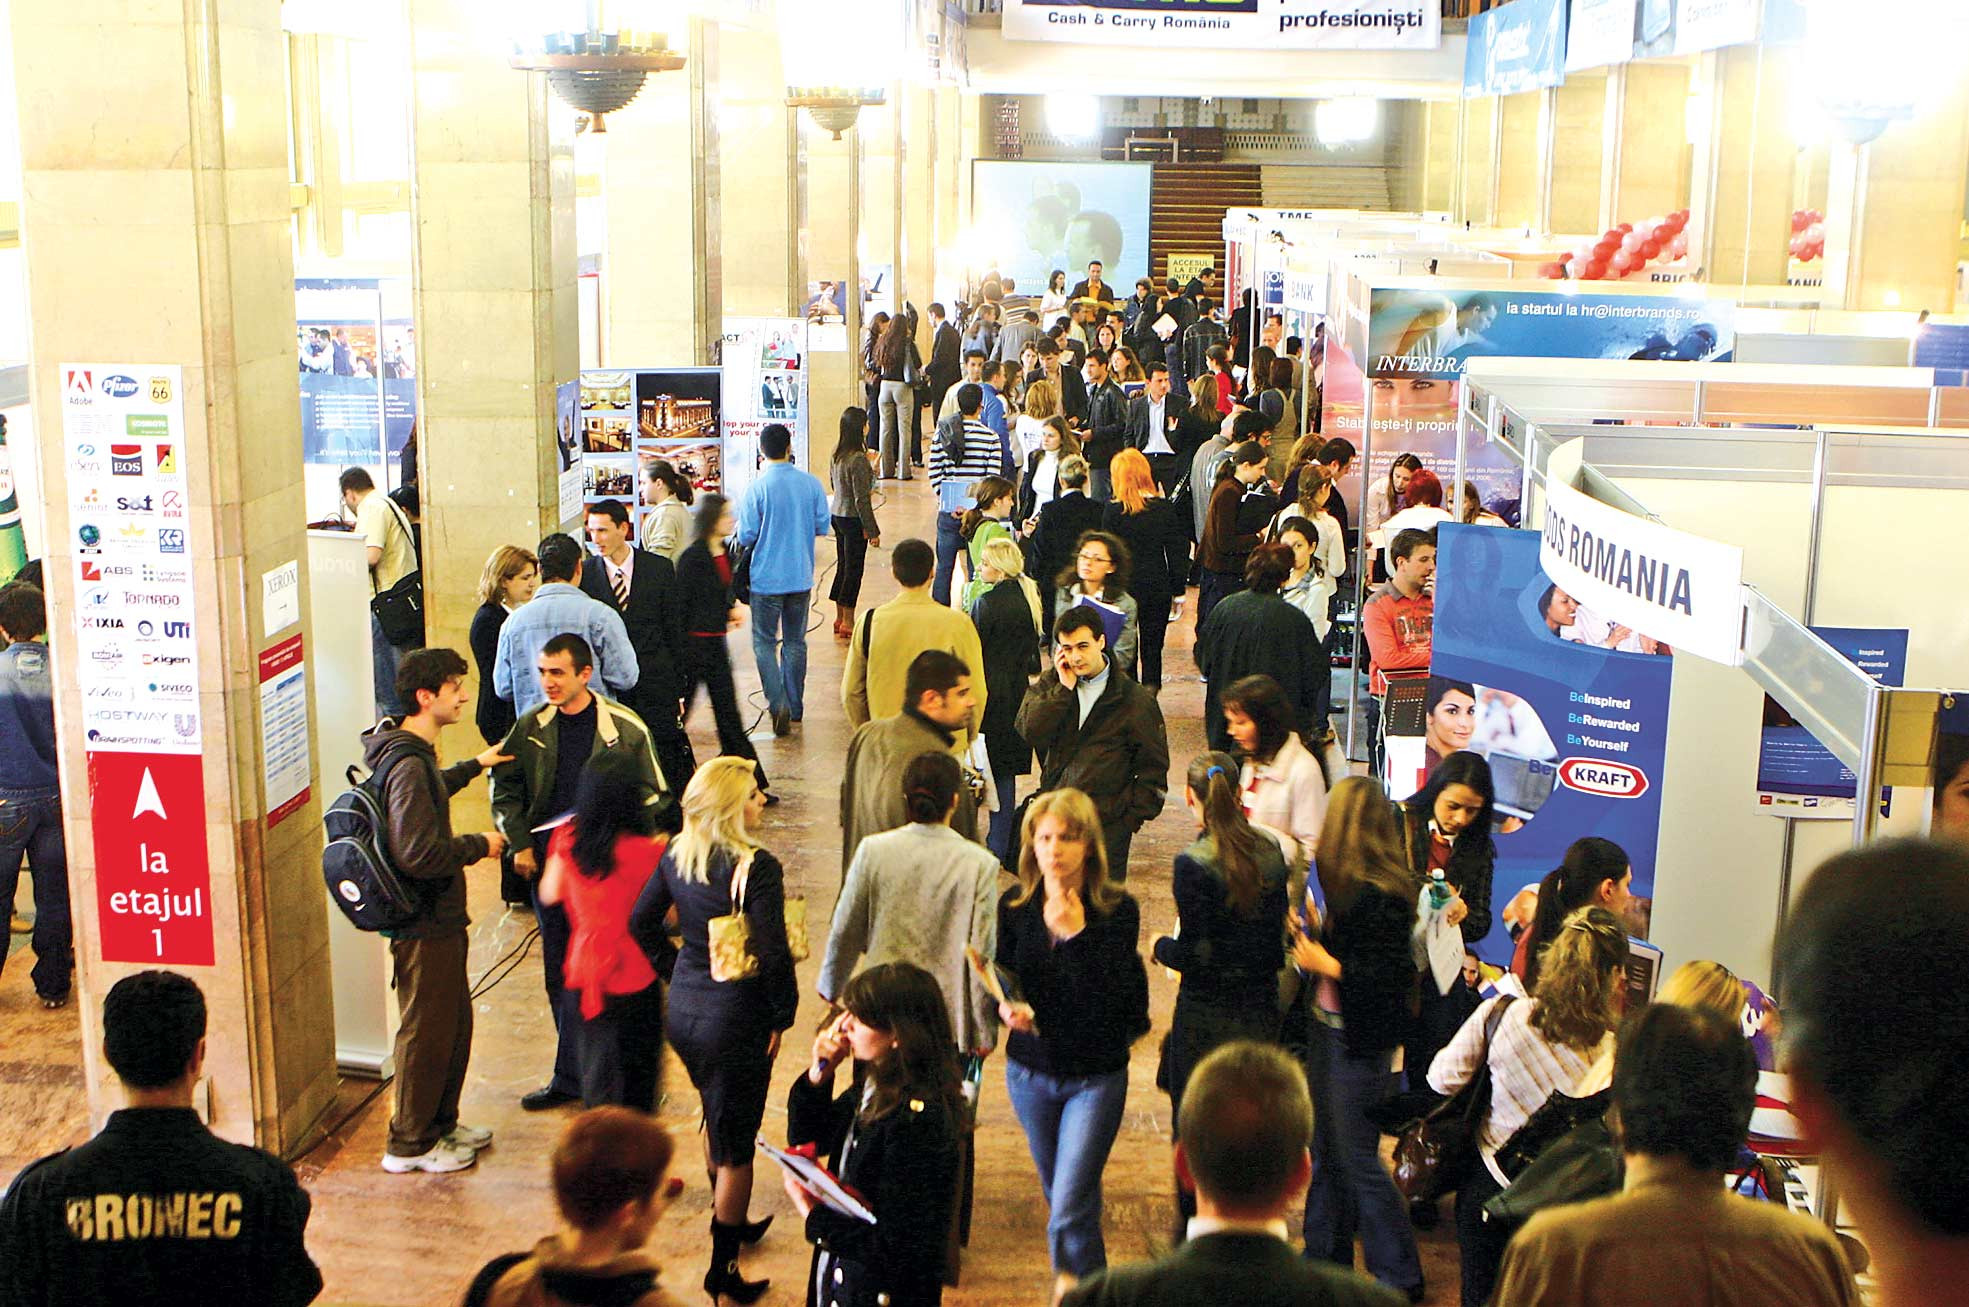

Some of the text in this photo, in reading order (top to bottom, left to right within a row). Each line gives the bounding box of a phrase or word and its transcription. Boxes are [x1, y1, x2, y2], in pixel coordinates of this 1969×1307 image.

[1048, 12, 1231, 30] Cash & Carry România
[1522, 302, 1562, 316] startul
[1566, 304, 1578, 316] la
[70, 397, 92, 405] Adobe
[152, 387, 168, 400] 66
[740, 421, 760, 429] your
[114, 462, 141, 473] EOS
[104, 566, 133, 574] ABS
[1569, 524, 1692, 616] ROMANIA
[268, 568, 296, 596] XEROX
[96, 618, 124, 628] IXIA
[1570, 692, 1631, 710] BeInspired
[89, 710, 168, 720] HOSTWAY
[1568, 713, 1640, 732] BeRewarded
[1568, 734, 1630, 752] BeYourself
[1575, 768, 1631, 788] KRAFT
[140, 842, 170, 874] la
[110, 887, 202, 922] etajul
